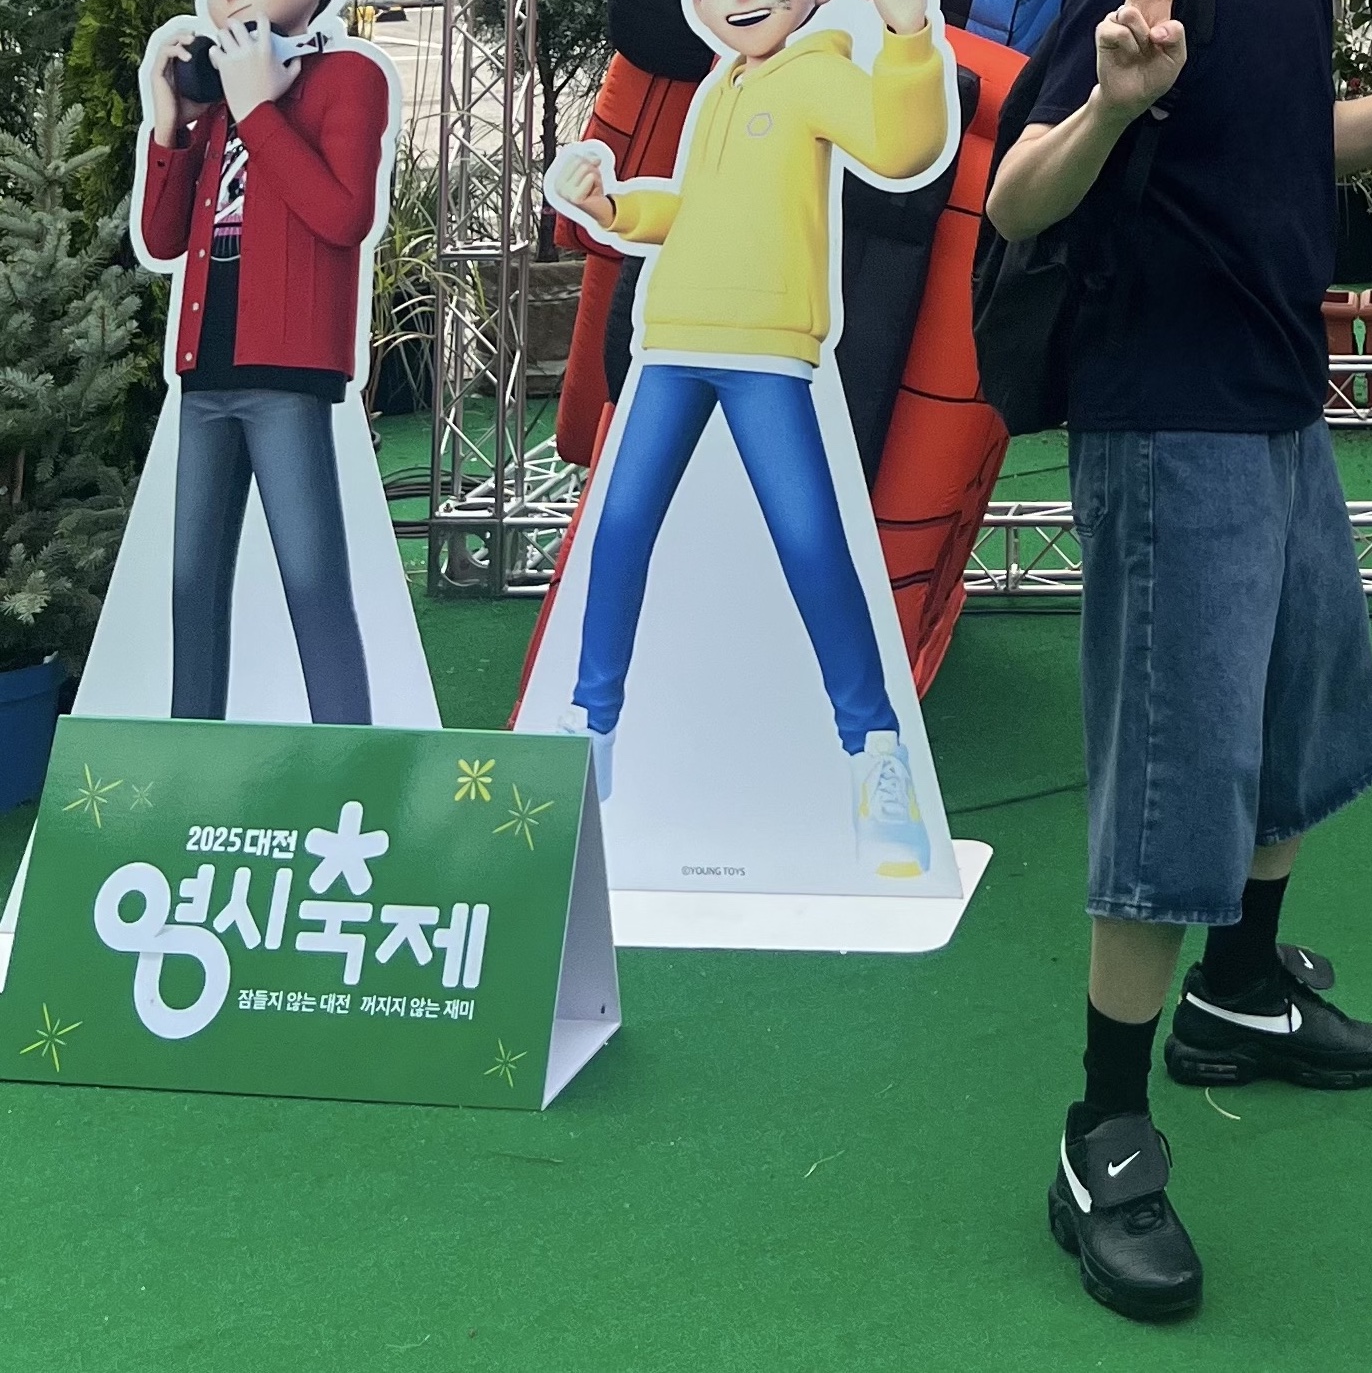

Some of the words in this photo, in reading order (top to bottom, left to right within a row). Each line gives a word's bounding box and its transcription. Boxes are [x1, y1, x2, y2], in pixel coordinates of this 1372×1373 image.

[723, 866, 746, 877] TOYS
[238, 989, 284, 1011] 잠들지
[286, 991, 317, 1013] 않는
[319, 993, 351, 1015] 대전
[360, 994, 406, 1017] 꺼지지
[410, 997, 441, 1019] 않는
[443, 999, 475, 1021] 재미
